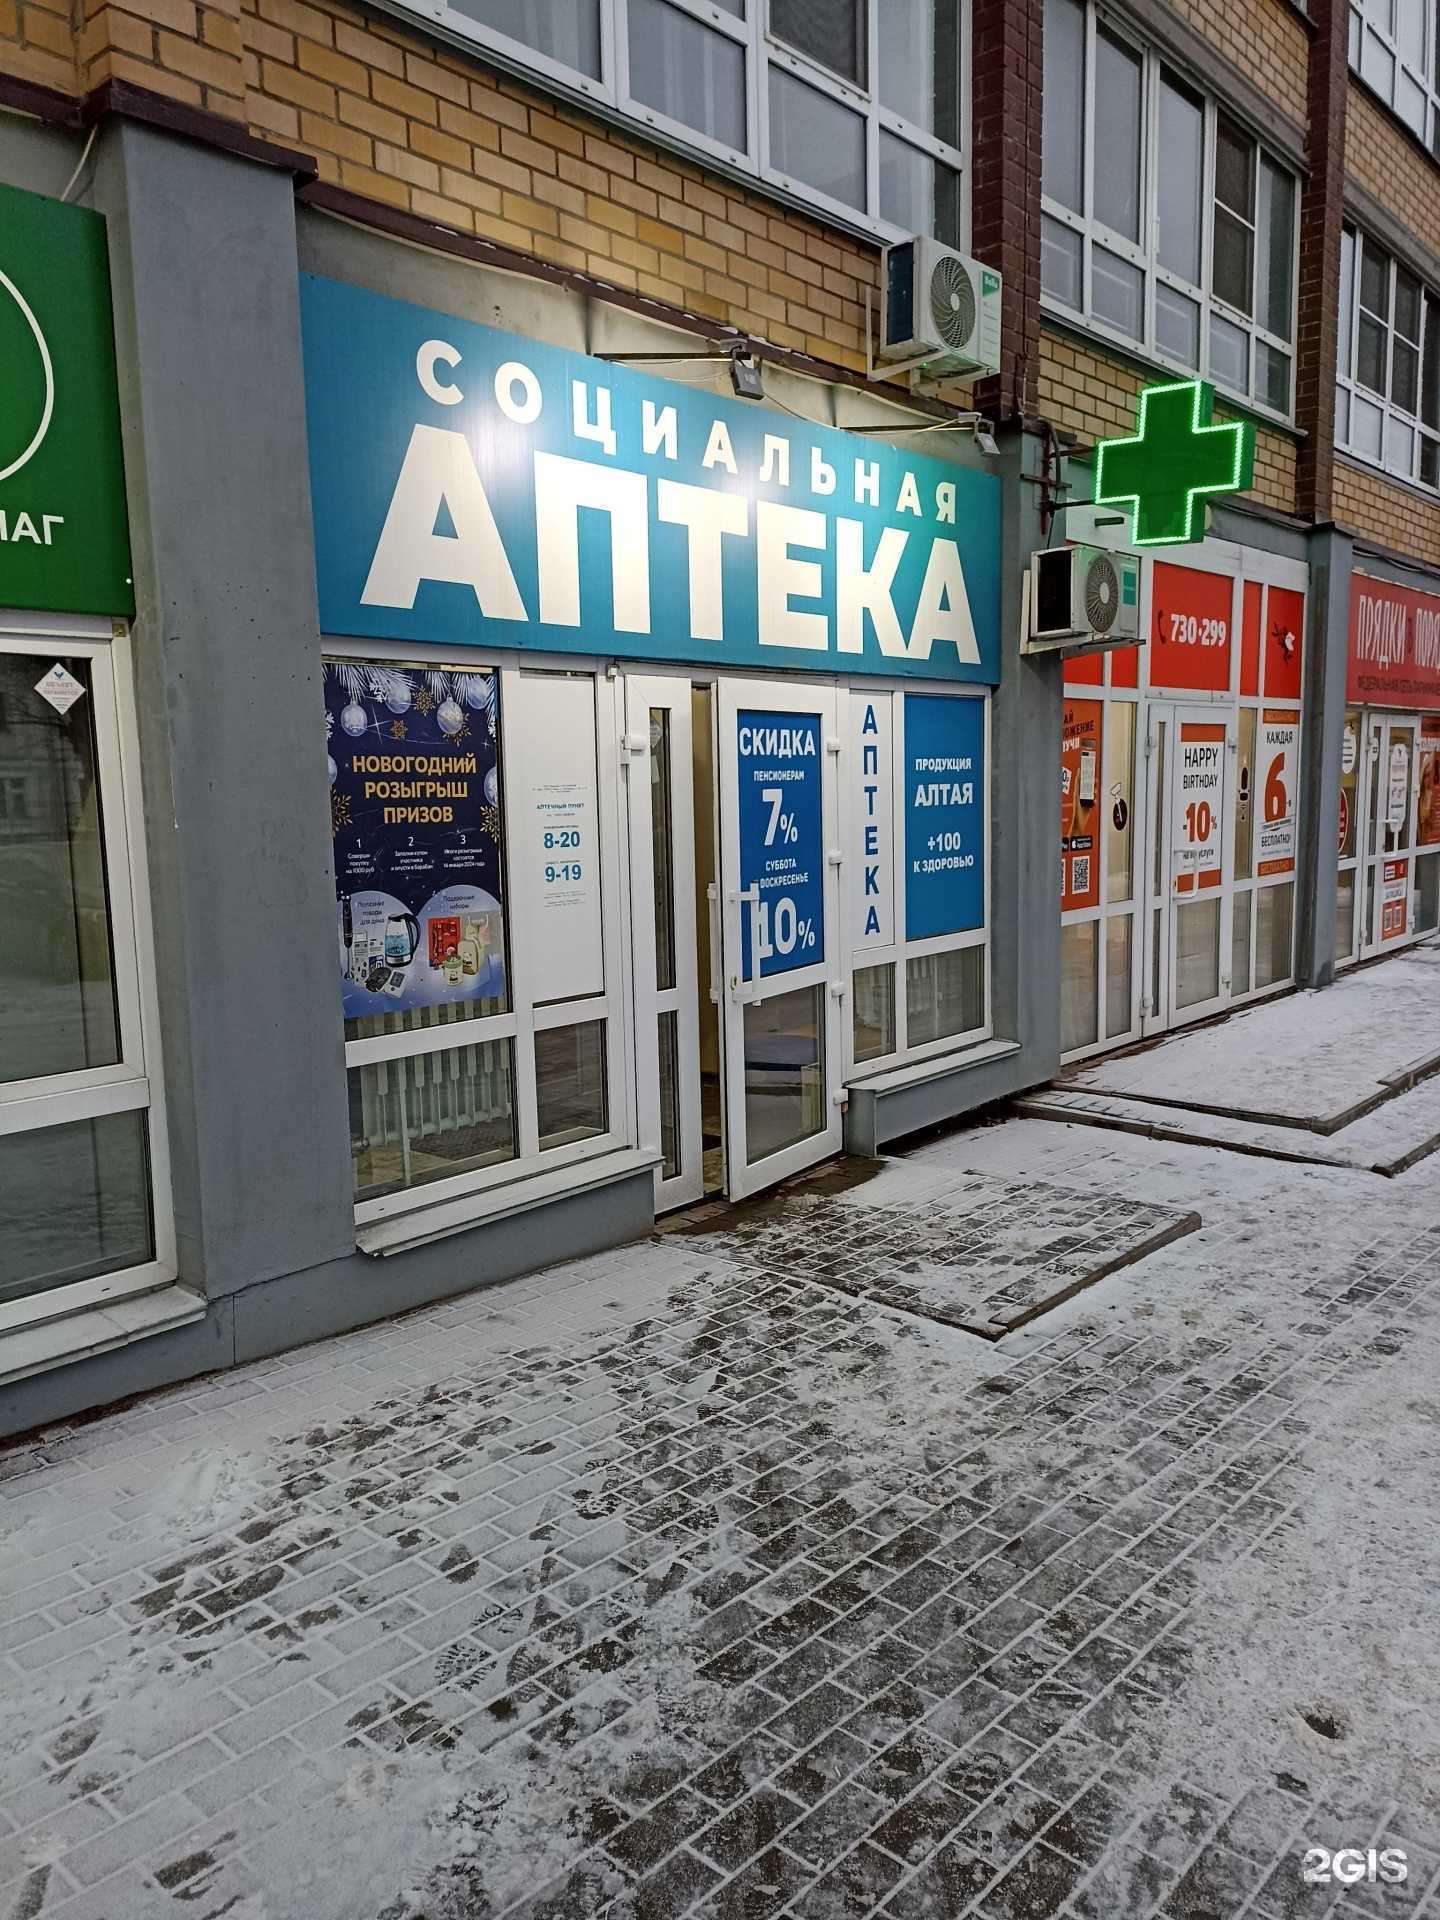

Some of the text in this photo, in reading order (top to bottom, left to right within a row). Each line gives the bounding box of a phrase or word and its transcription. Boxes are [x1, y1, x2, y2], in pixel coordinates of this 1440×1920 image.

[416, 339, 957, 524] СОЦИАЛЬНАЯ
[0, 510, 64, 545] АГ
[360, 423, 981, 664] АПТЕКА
[1357, 594, 1407, 671] ПРЯДКИ
[739, 727, 816, 759] СКИДКА
[1266, 730, 1293, 744] КАЖДАЯ
[352, 752, 477, 776] НОВОГОДНИЙ
[915, 758, 972, 771] ПРОДУКЦИЯ
[1184, 748, 1218, 767] HAPPY
[754, 770, 804, 781] ПЕНСИОНЕРАМ
[1183, 774, 1218, 789] BIRTHDAY
[365, 781, 468, 799] РОЗЫГРЫШ
[915, 783, 973, 806] АЛТАЯ
[383, 806, 454, 824] ПРИЗОВ
[762, 788, 798, 846] 7%
[862, 705, 880, 935] АПТЕКА
[356, 838, 361, 848] 1
[408, 836, 415, 847] 2
[460, 834, 467, 845] 3
[543, 831, 581, 849] 8-20
[927, 832, 961, 852] +100
[545, 864, 582, 882] 9-19
[765, 859, 797, 871] СУББОТА
[914, 855, 974, 873] К ЗДОРОВЬЮ
